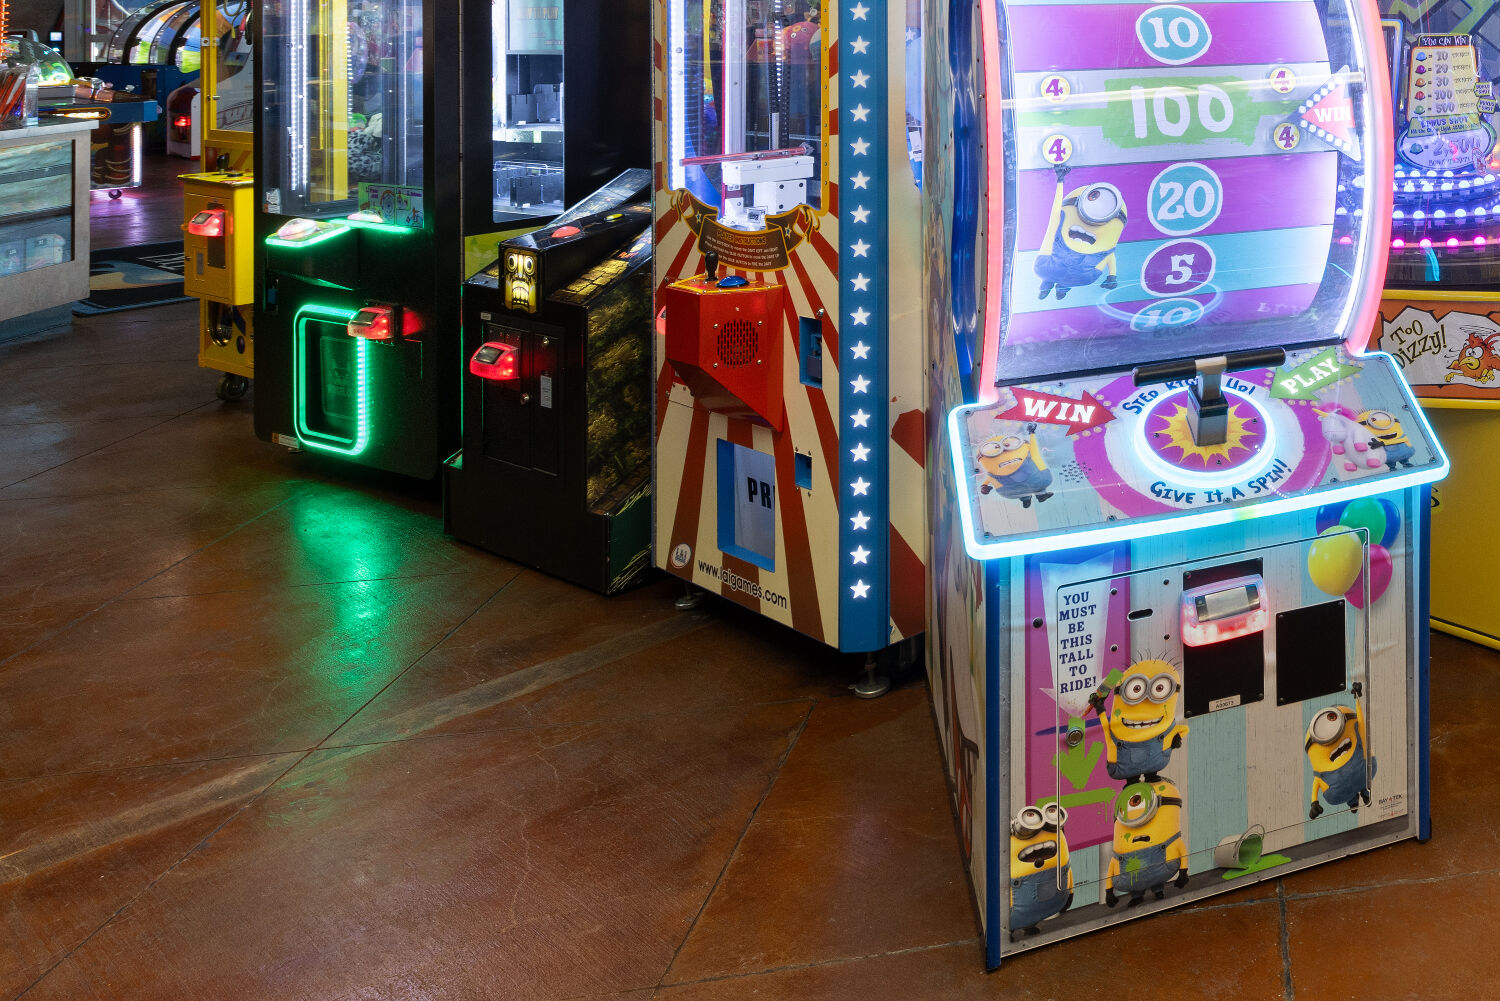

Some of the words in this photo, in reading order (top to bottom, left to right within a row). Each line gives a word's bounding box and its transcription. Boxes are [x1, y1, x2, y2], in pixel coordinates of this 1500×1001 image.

[1147, 15, 1199, 49] 10
[1422, 37, 1436, 46] YOU
[1438, 36, 1452, 45] CAN
[1454, 36, 1467, 44] WIN
[1435, 51, 1449, 61] 10
[1046, 79, 1063, 97] 4
[1434, 90, 1453, 101] 100
[1130, 83, 1234, 139] 100
[1314, 106, 1352, 122] WIN
[1435, 101, 1455, 113] 500
[1278, 126, 1295, 148] 4
[1048, 139, 1066, 162] 4
[1158, 180, 1213, 219] 20
[1166, 254, 1195, 285] 5
[1280, 357, 1340, 395] PLAY
[1122, 390, 1159, 415] STEP
[1165, 377, 1199, 391] RIG
[1023, 397, 1097, 424] WIN
[1150, 481, 1196, 504] GIVE
[1231, 486, 1246, 499] A
[1248, 458, 1293, 494] SPIN!
[698, 560, 787, 609] www.laigames.com
[1063, 591, 1090, 606] YOU
[1059, 604, 1097, 622] MUST
[1068, 621, 1085, 634] BE
[1060, 634, 1092, 650] THIS
[1059, 649, 1094, 664] TALL
[1069, 664, 1088, 677] TO
[1060, 676, 1097, 694] RIDE!
